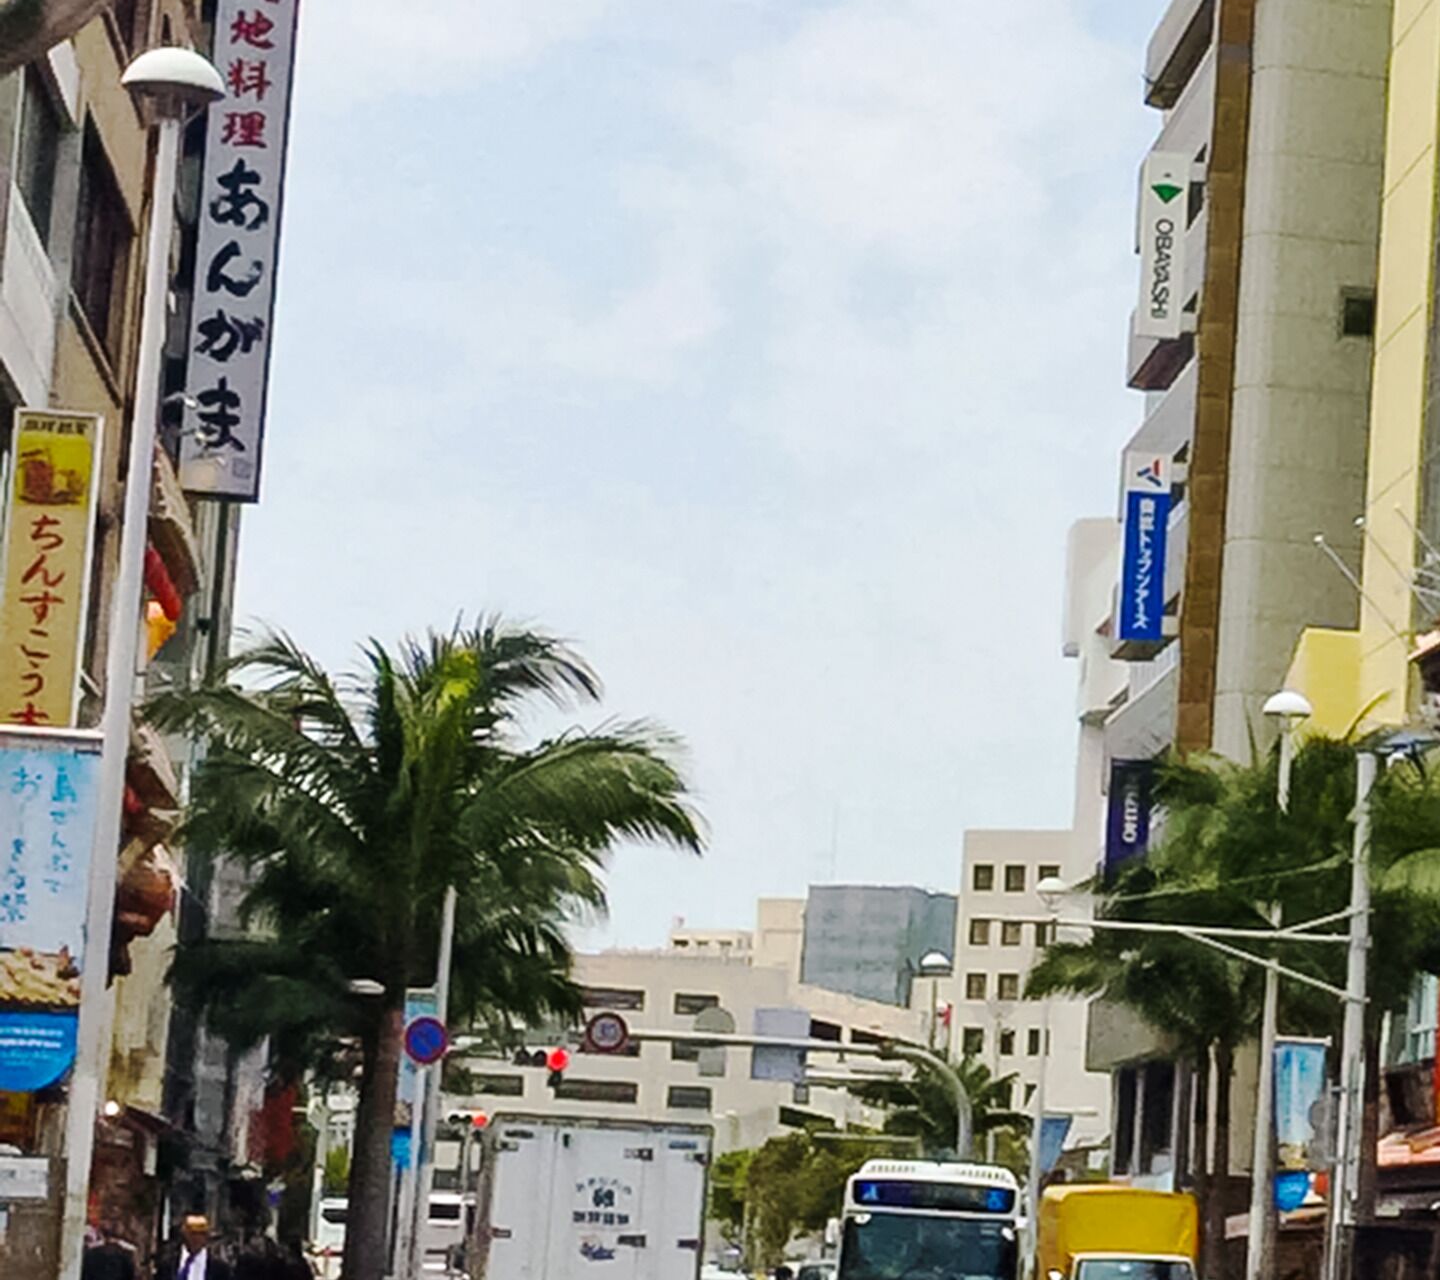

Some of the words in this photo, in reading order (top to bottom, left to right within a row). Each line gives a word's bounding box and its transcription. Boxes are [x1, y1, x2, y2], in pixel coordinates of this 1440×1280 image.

[194, 157, 269, 452] あんがま
[1151, 218, 1174, 319] OBAYASHI
